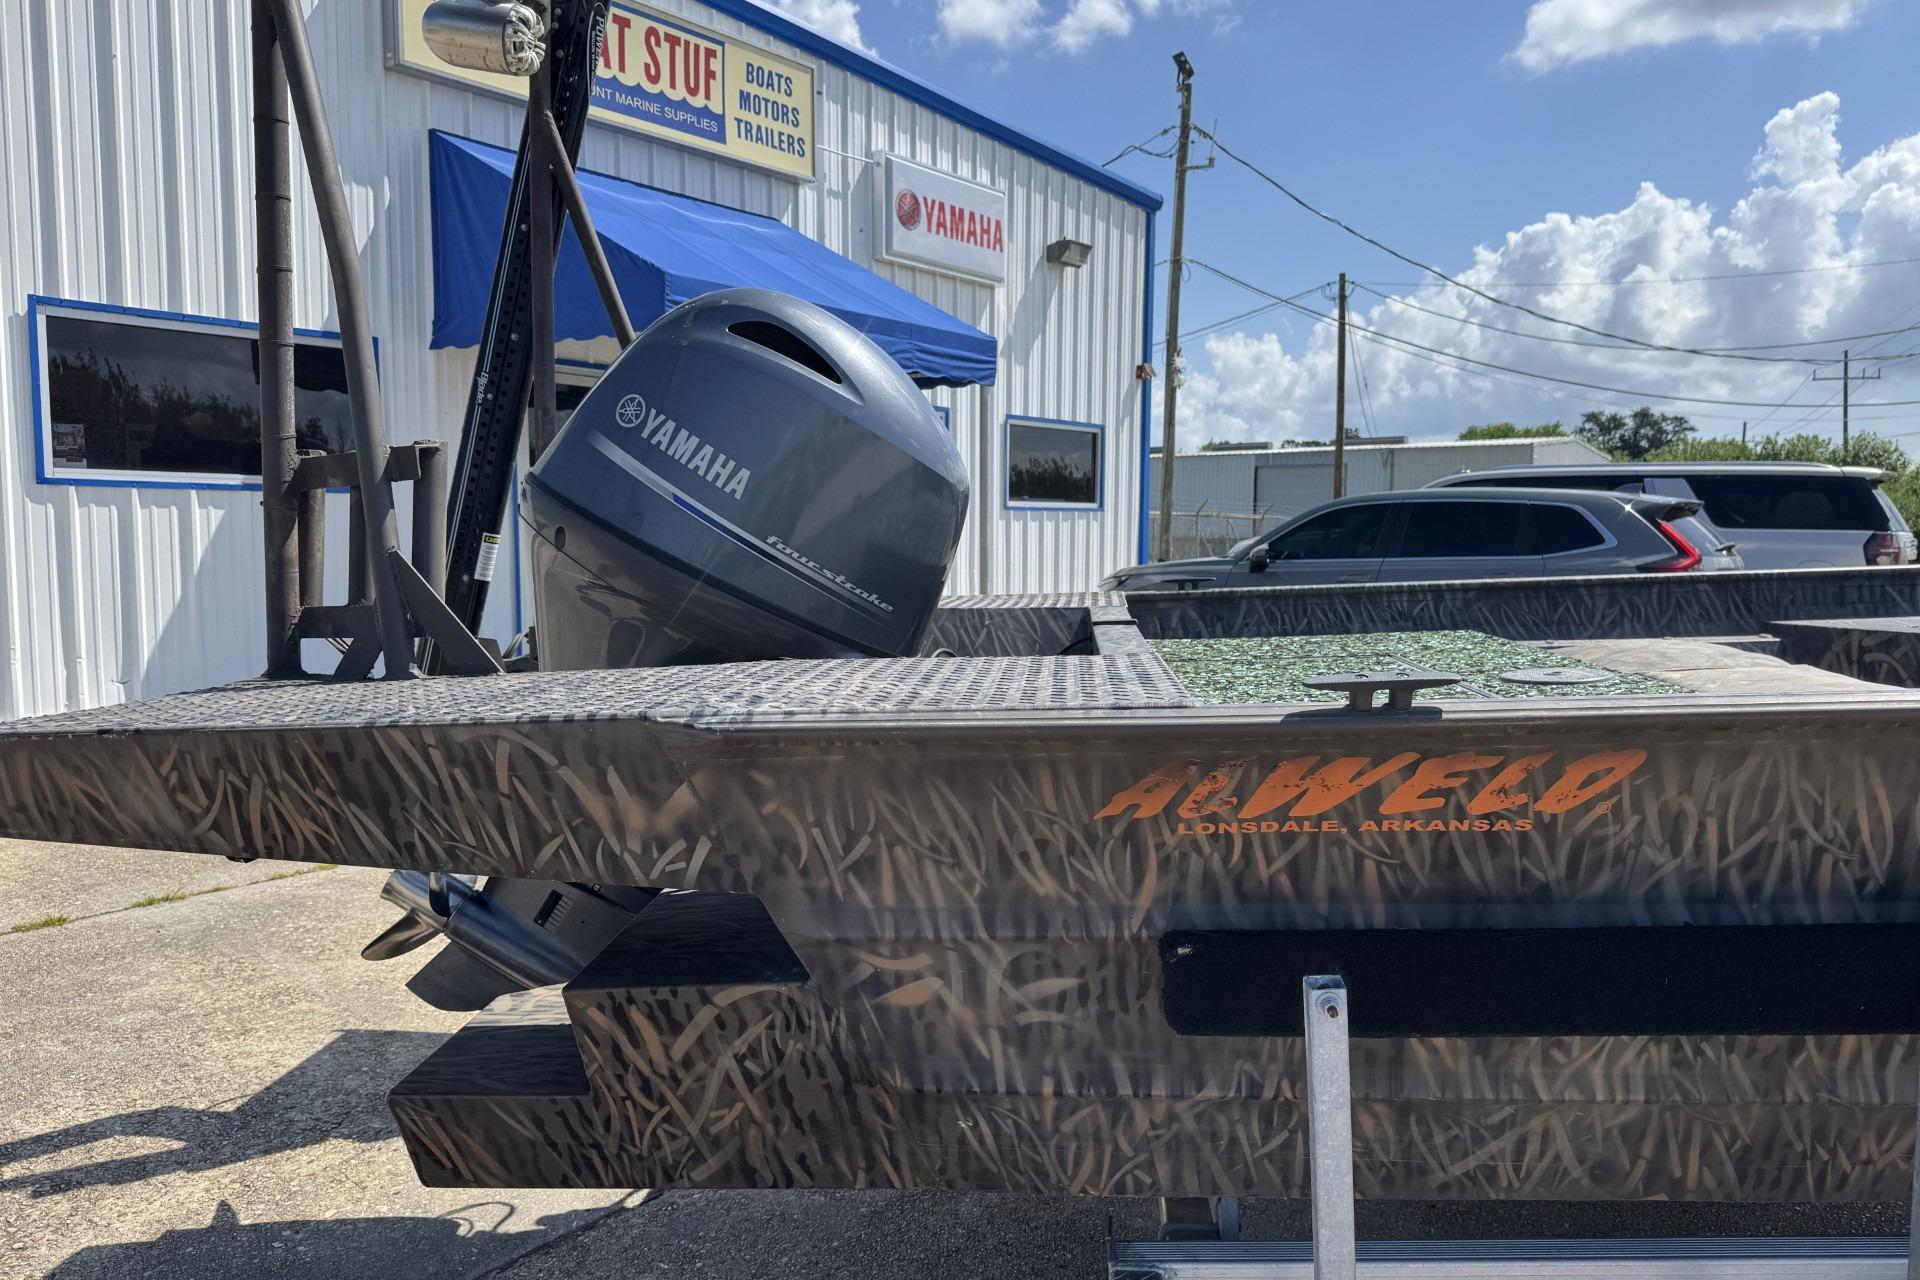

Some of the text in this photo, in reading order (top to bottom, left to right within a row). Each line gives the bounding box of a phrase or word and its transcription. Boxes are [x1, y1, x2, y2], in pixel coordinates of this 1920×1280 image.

[643, 26, 717, 101] STUF
[746, 62, 793, 97] BOATS
[615, 91, 662, 115] MARINE
[664, 107, 718, 133] SUPPLIES
[739, 88, 800, 128] MOTORS
[734, 116, 805, 158] TRAILERS
[922, 195, 1004, 254] YAMAHA
[640, 407, 751, 501] YAMAHA
[1177, 819, 1534, 835] LONSDALE, ARKANSAS
